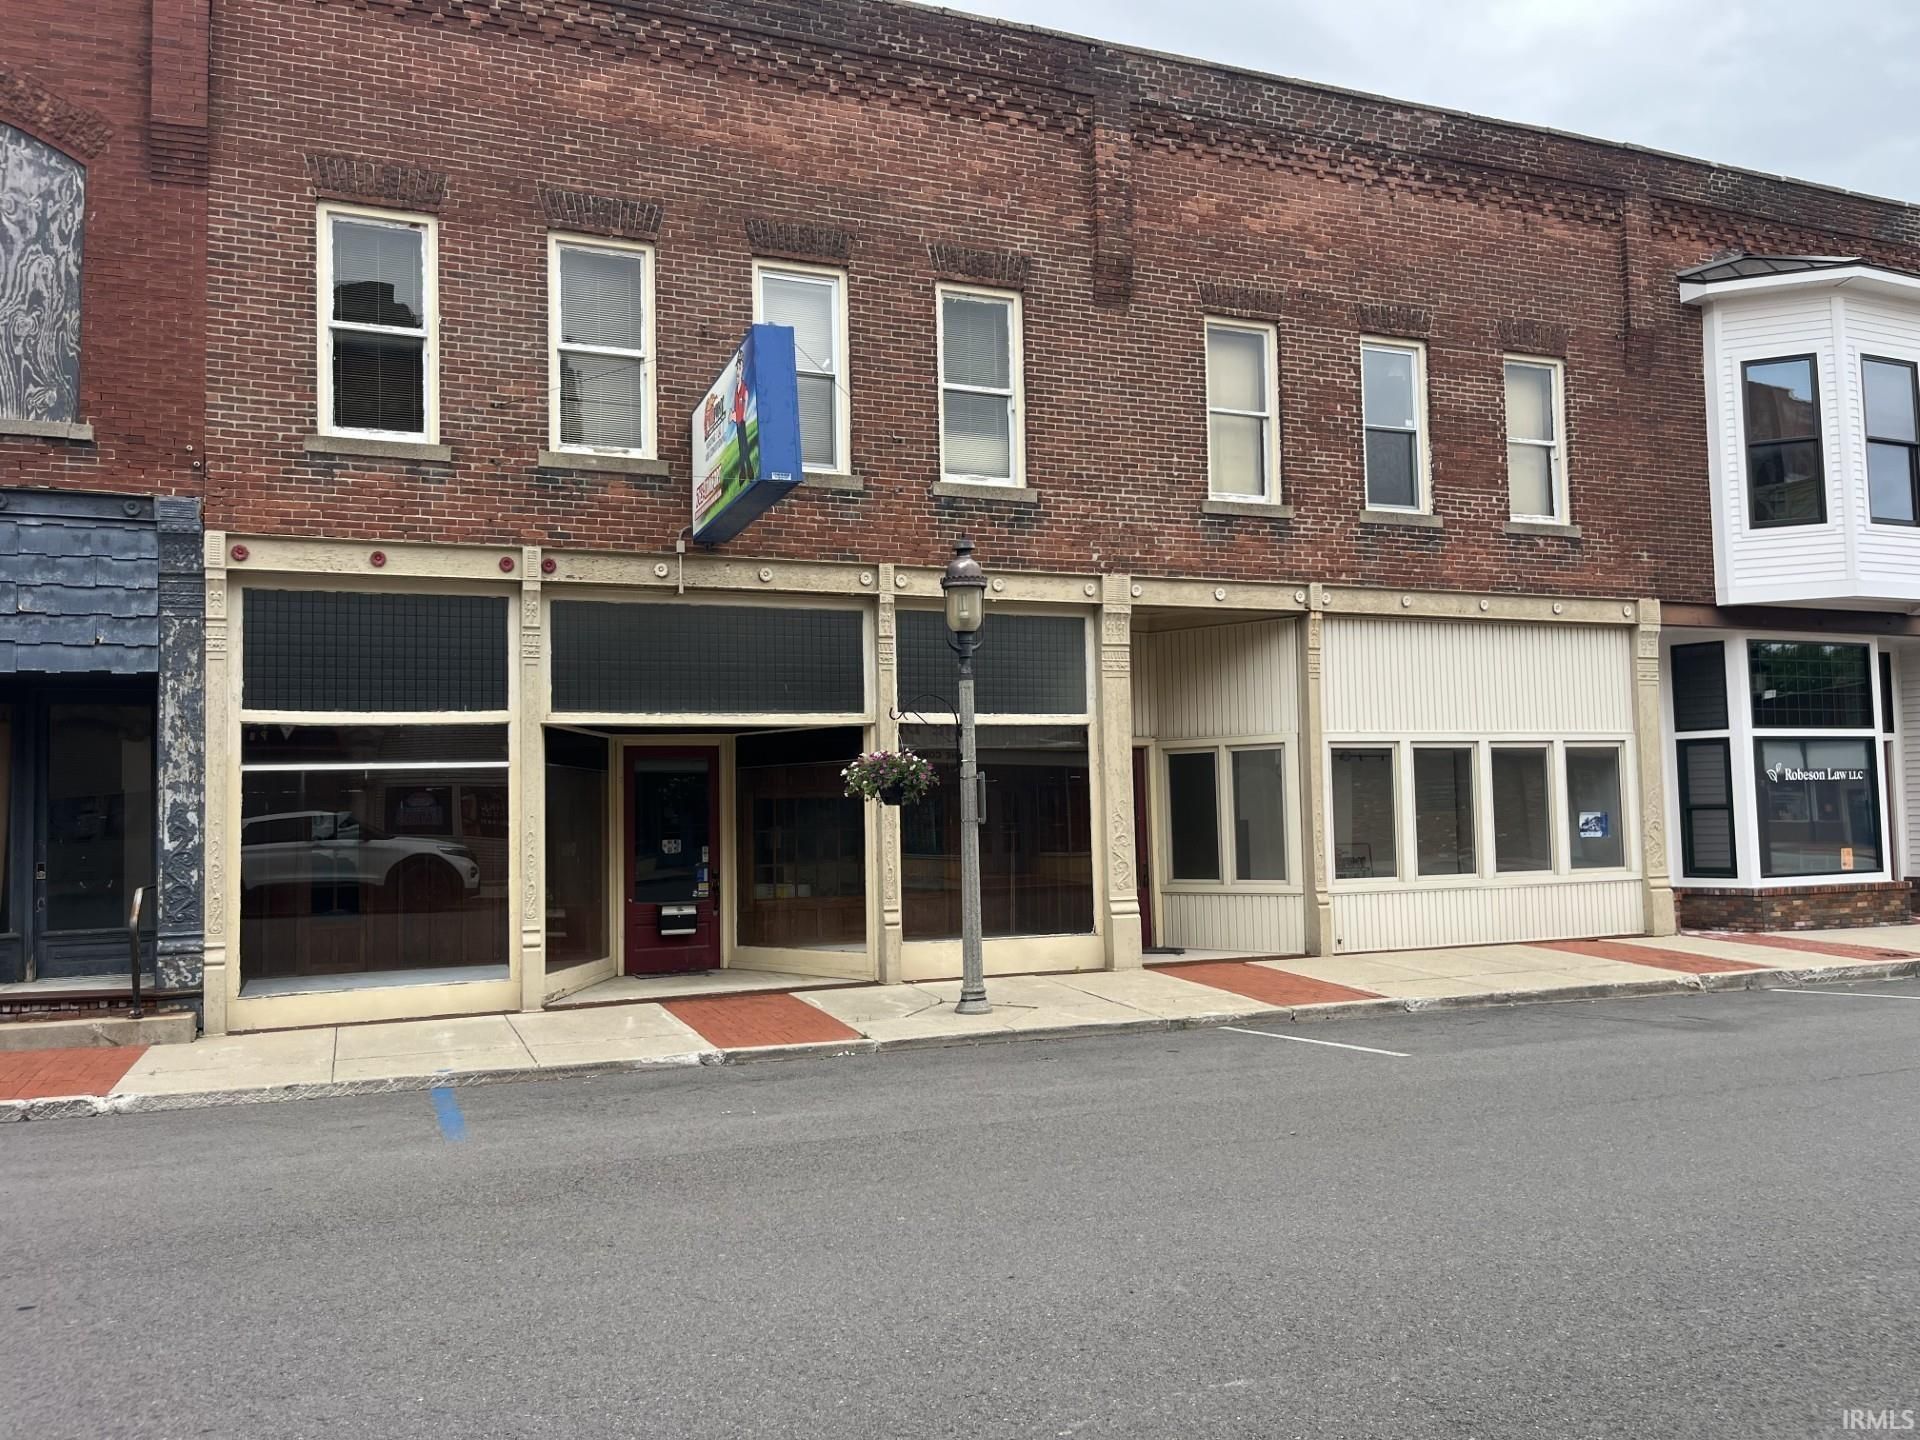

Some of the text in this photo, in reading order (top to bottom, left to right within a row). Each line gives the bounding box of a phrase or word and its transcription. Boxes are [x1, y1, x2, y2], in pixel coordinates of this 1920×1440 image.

[1785, 768, 1864, 781] Robeson Law LLC
